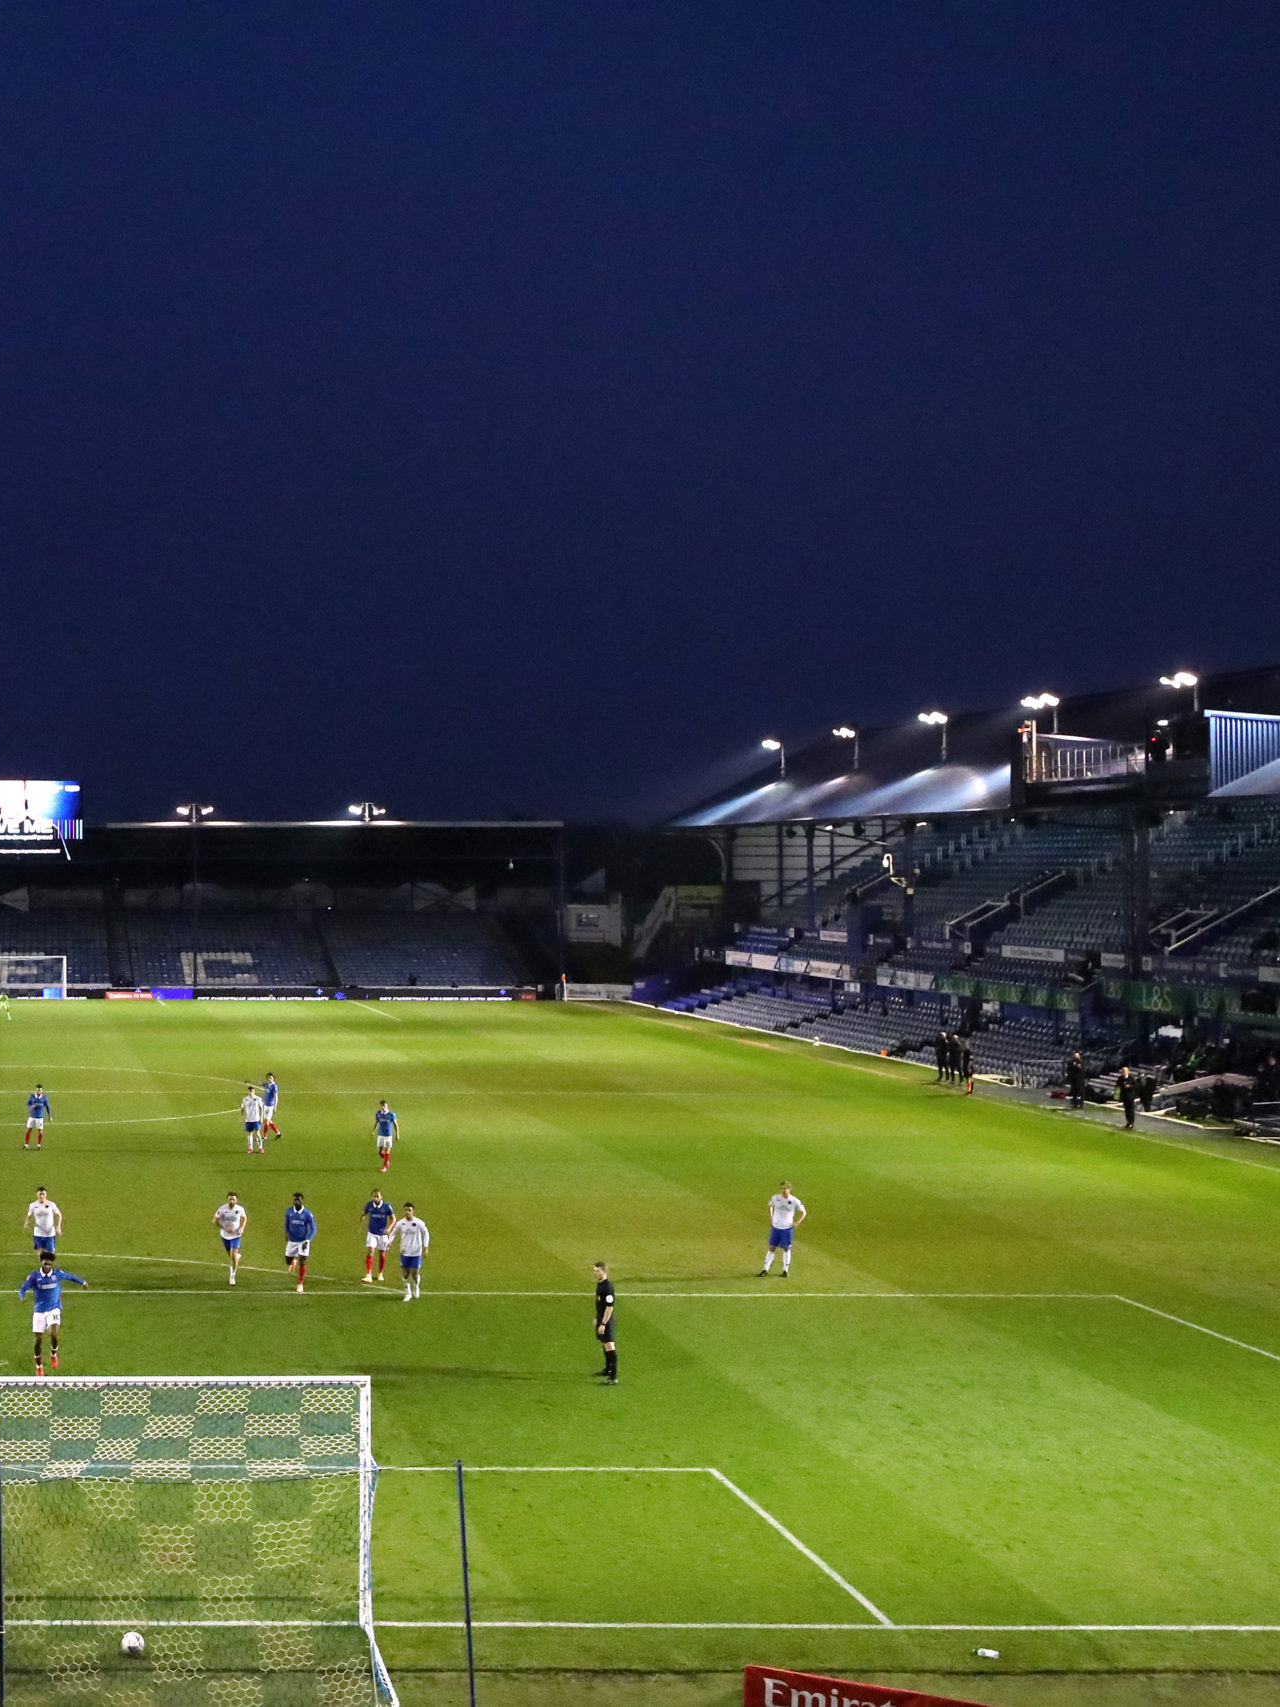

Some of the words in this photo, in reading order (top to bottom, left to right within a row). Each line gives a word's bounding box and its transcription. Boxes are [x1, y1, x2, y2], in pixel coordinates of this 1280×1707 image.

[24, 820, 53, 834] ME
[1142, 986, 1172, 1012] L&S
[1196, 989, 1218, 1009] L&S
